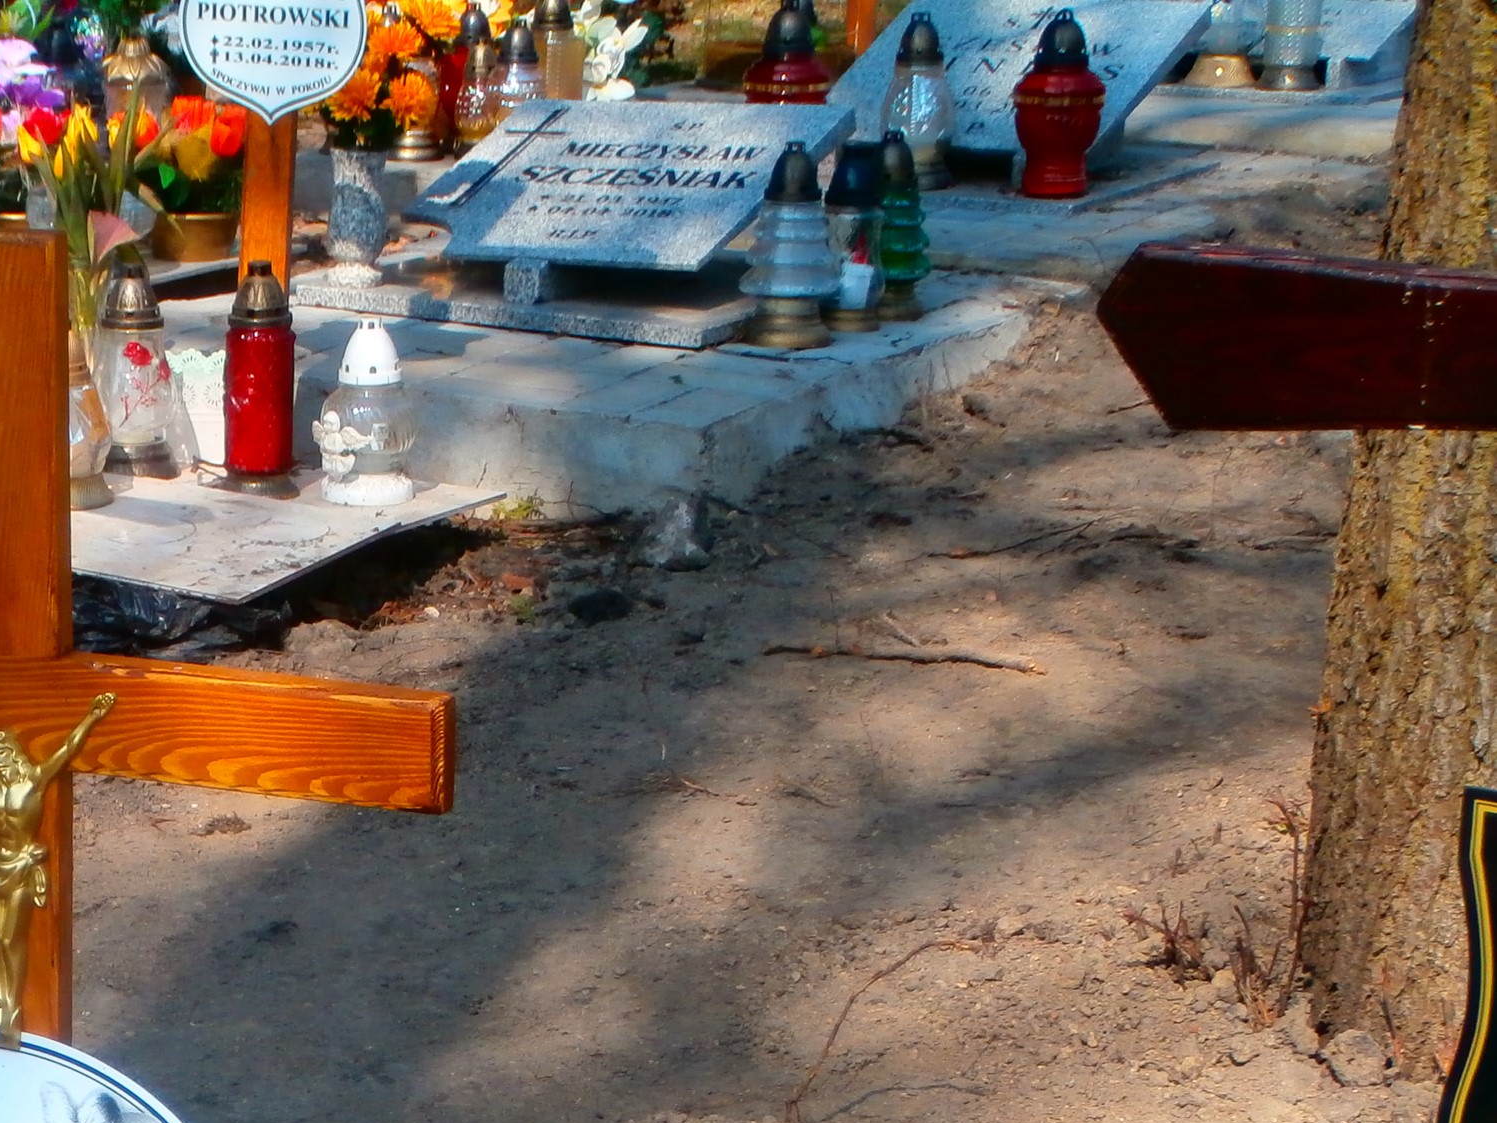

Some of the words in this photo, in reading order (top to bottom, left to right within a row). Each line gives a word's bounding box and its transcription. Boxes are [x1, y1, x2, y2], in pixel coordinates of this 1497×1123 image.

[197, 2, 351, 29] PIOTROWSKI
[223, 36, 340, 55] 22.02.1957r.
[224, 51, 340, 70] 13.04.2018r.
[211, 68, 271, 96] SPOCZYWAJ
[276, 87, 286, 96] W
[291, 75, 333, 96] POKOJU
[560, 141, 766, 162] MIECZYSŁAW
[516, 164, 758, 190] SZCZEŚNIAK
